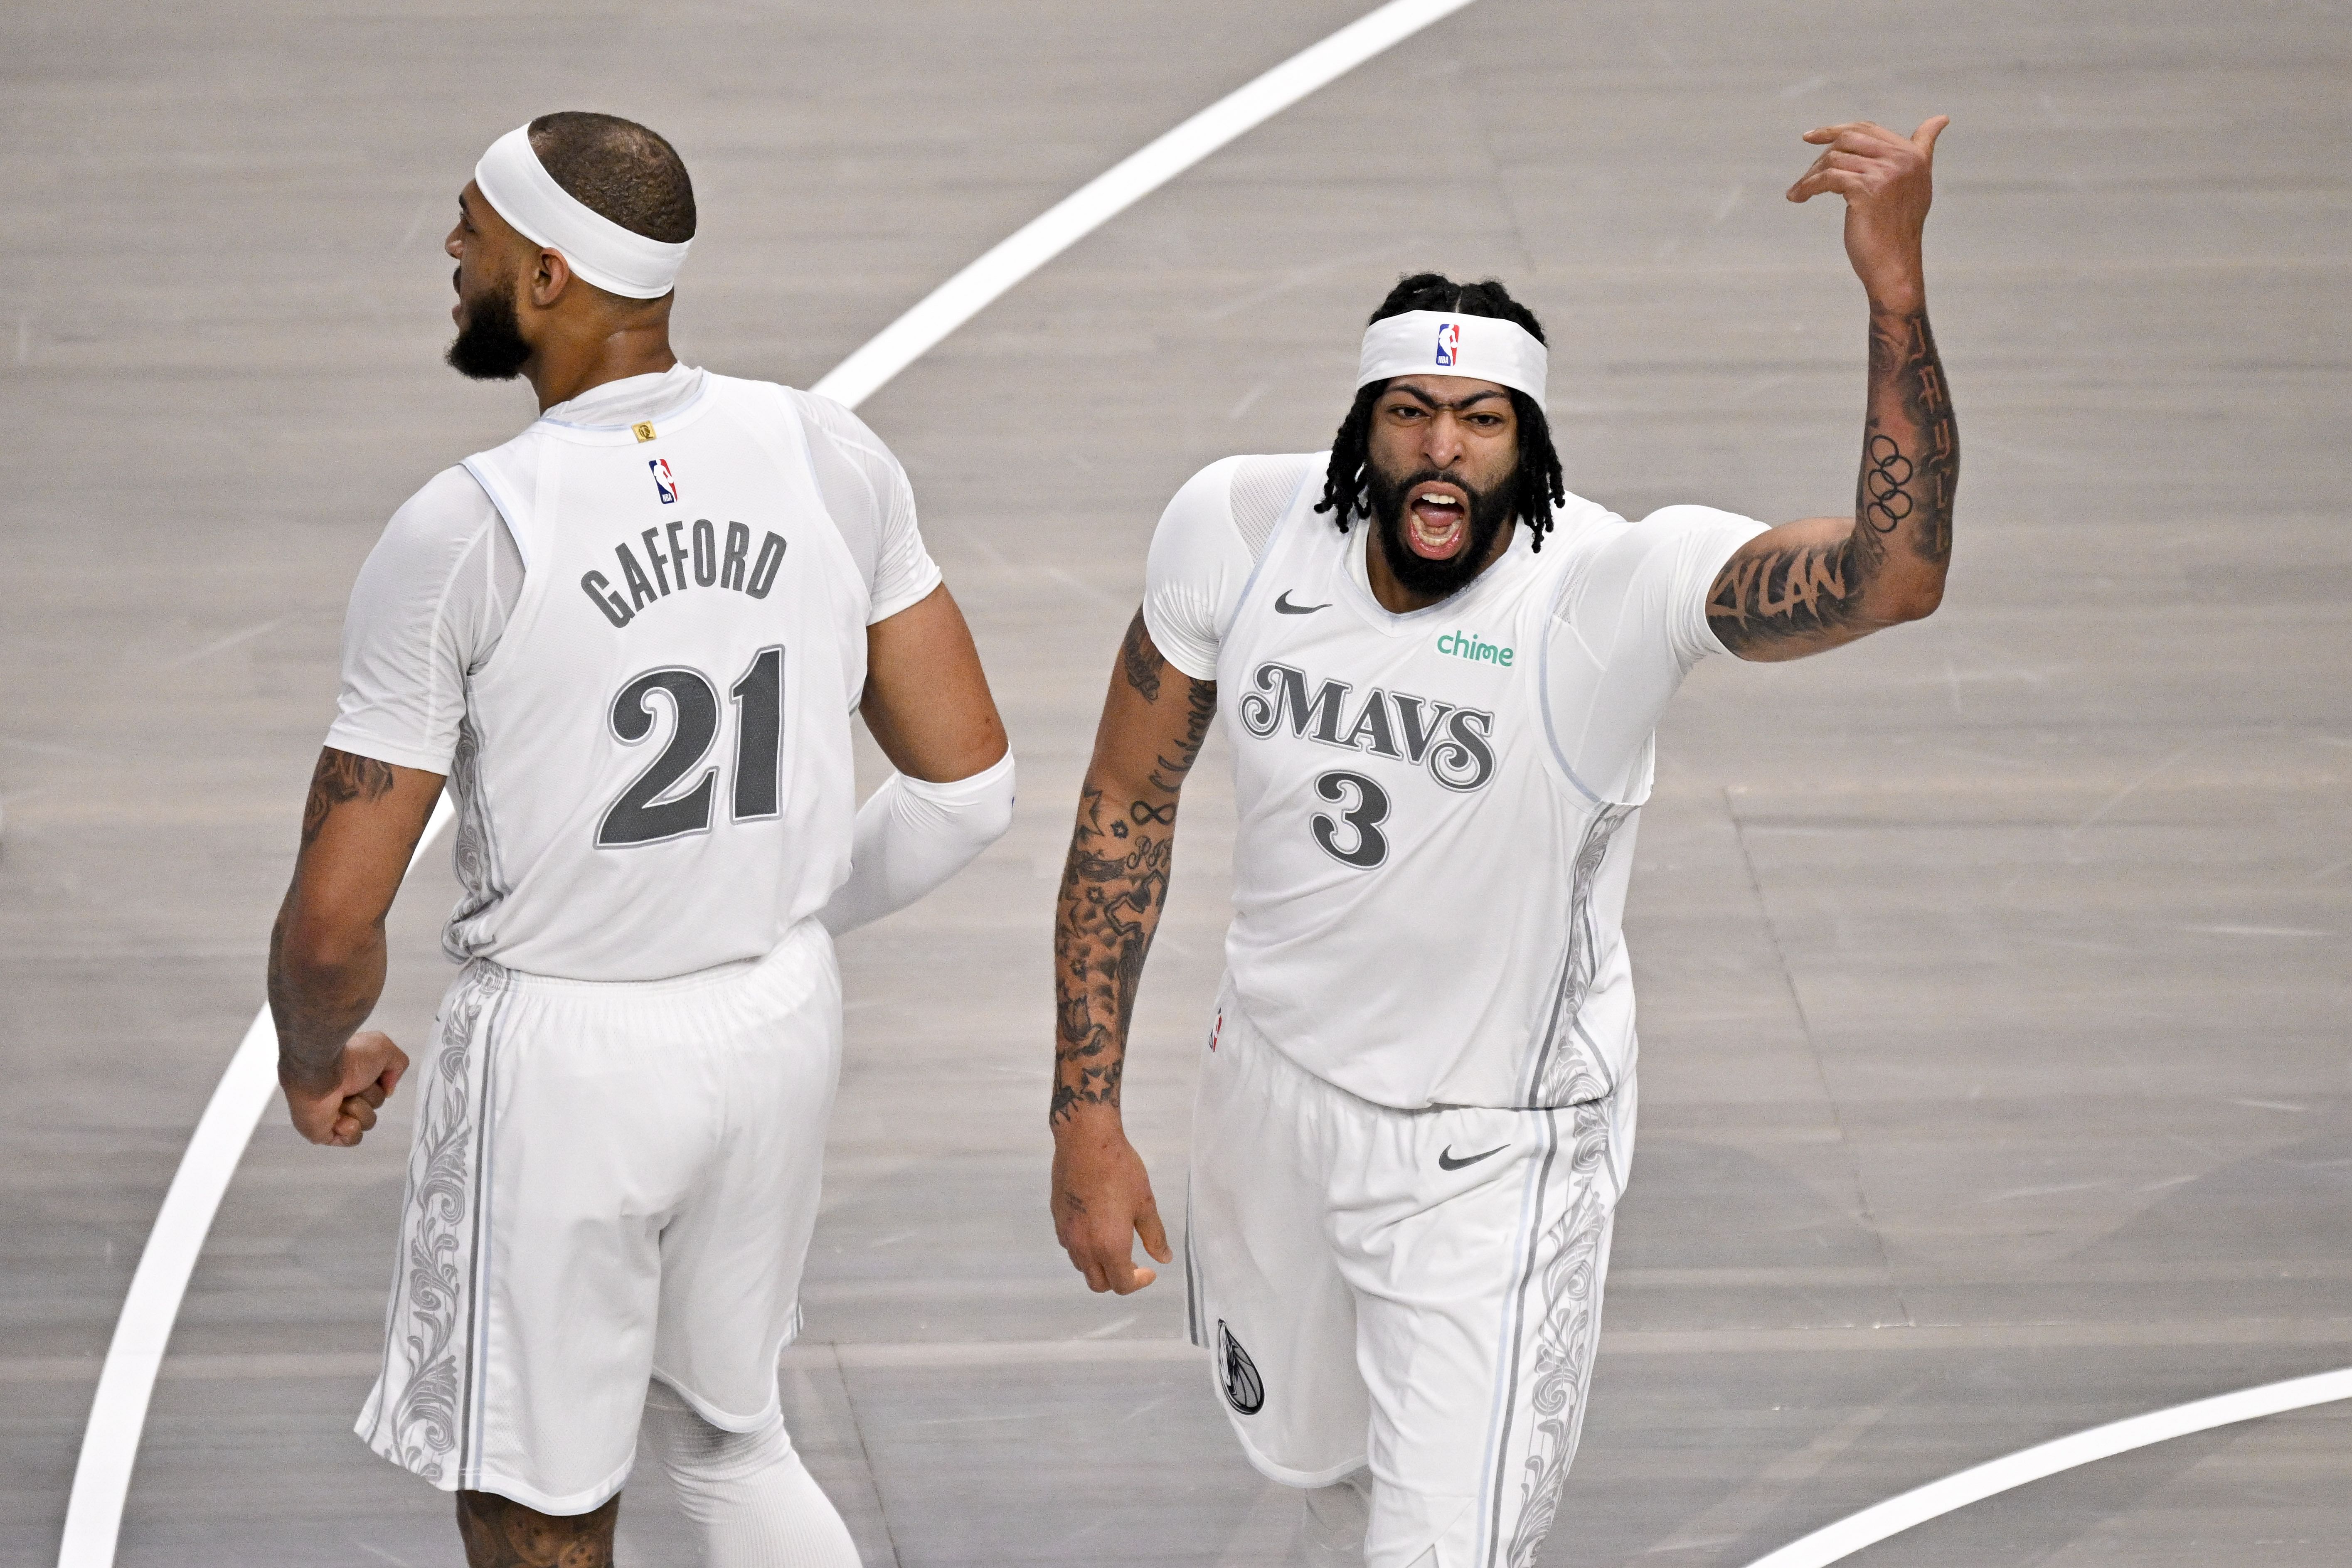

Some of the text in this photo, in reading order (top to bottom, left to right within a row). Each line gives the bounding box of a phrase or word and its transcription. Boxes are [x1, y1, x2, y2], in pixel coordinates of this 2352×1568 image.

[1438, 355, 1449, 364] NBA
[662, 493, 672, 502] NBA
[581, 519, 787, 628] GAFFORD
[1437, 630, 1514, 667] chime
[593, 644, 785, 850] 21
[1239, 661, 1496, 793] MAVS
[1309, 769, 1392, 871] 3
